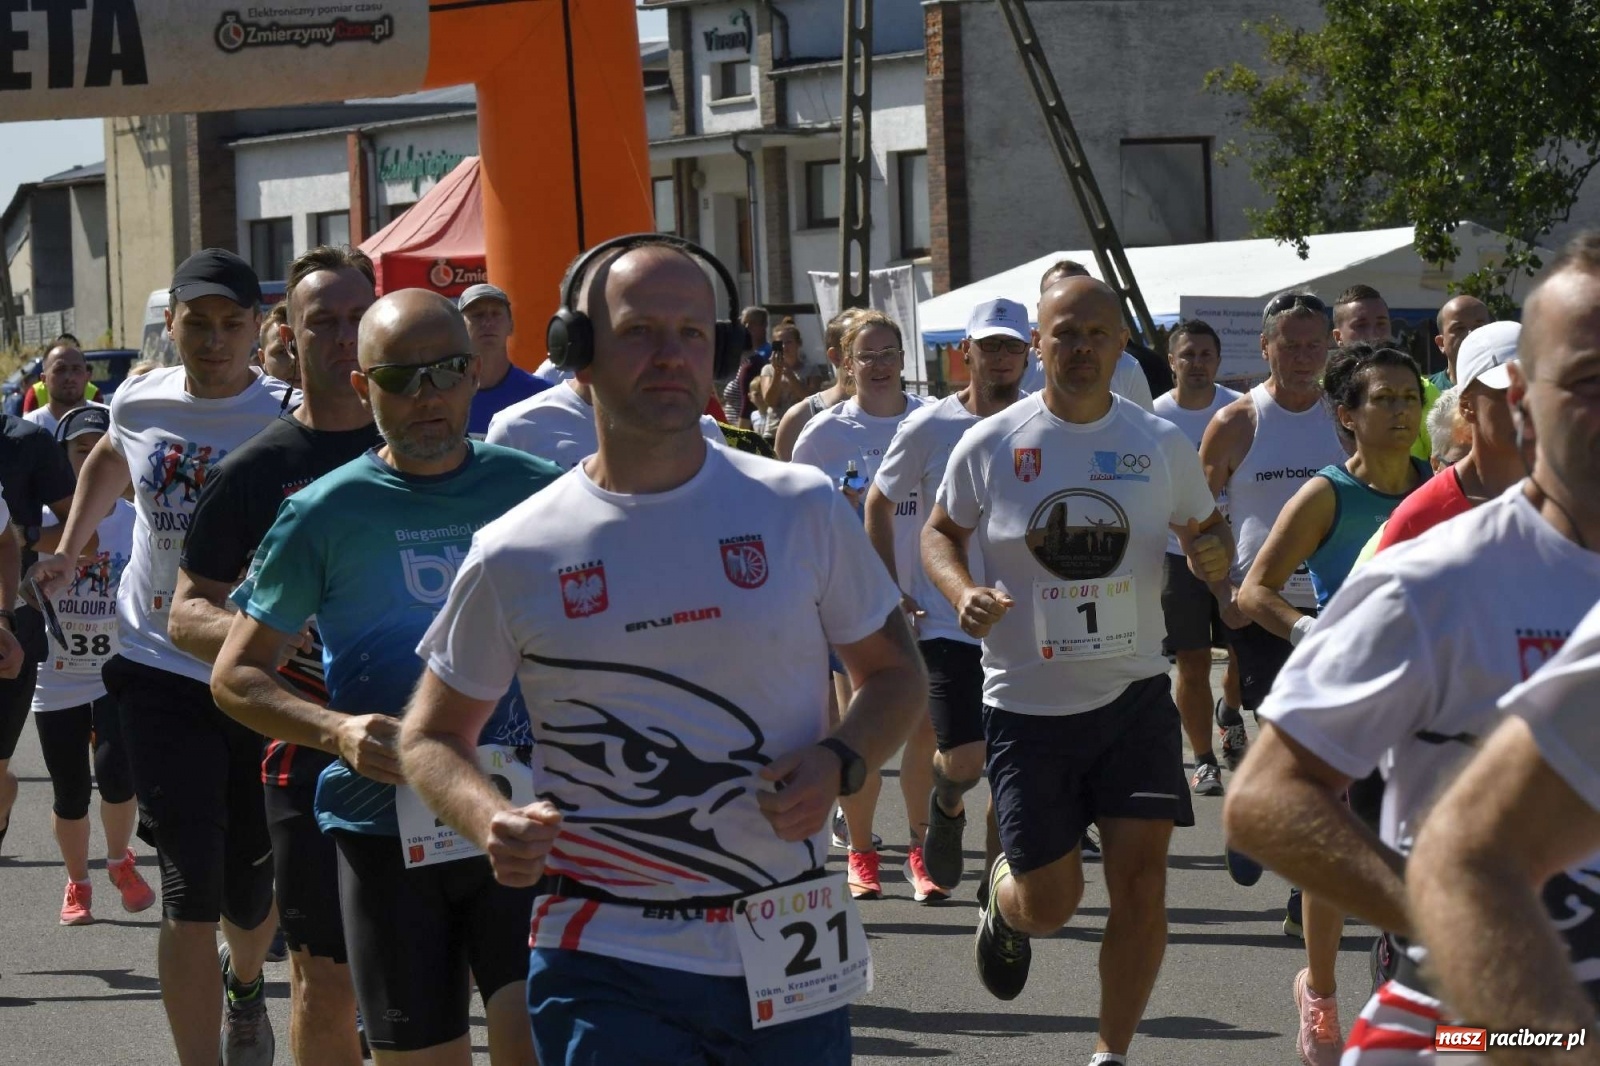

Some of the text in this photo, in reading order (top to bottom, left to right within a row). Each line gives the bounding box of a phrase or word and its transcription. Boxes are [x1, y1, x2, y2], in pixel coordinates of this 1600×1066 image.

[247, 3, 383, 18] Elektroniczny pomiar czasu
[246, 19, 390, 44] ZmierzymyCzas.pl
[1255, 469, 1284, 481] new
[558, 559, 604, 575] POLSKA
[1042, 580, 1130, 600] COLOUR RUN
[58, 599, 106, 615] COLOUR
[1076, 601, 1098, 634] 1
[70, 633, 111, 656] 38
[779, 910, 849, 977] 21
